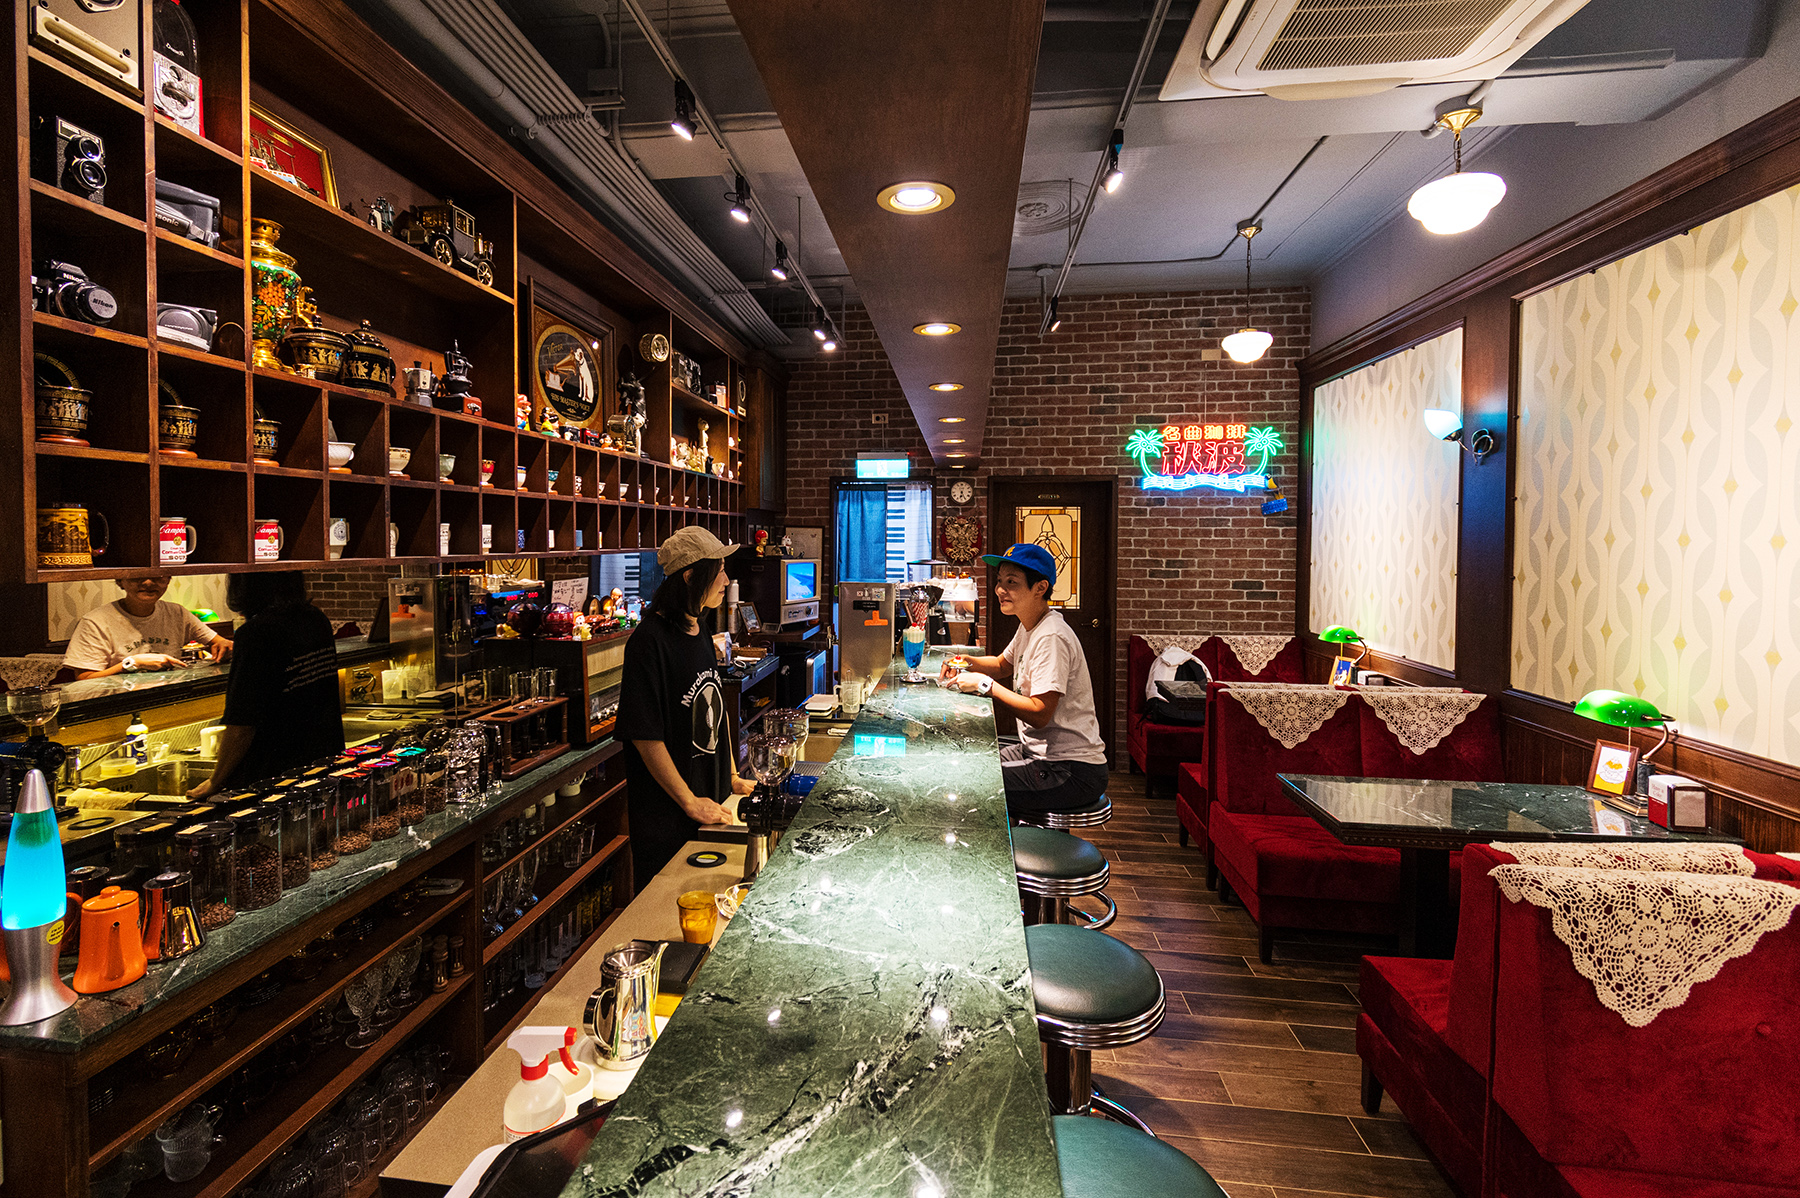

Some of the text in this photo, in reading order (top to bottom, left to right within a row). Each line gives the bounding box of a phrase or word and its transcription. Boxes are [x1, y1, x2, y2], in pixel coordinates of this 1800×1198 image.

[155, 212, 180, 227] sonic
[63, 272, 85, 283] Nikon
[92, 298, 114, 309] Nikon
[1162, 424, 1247, 441] 名曲珈琲
[1161, 441, 1247, 476] 秋波
[680, 667, 713, 707] Murakami
